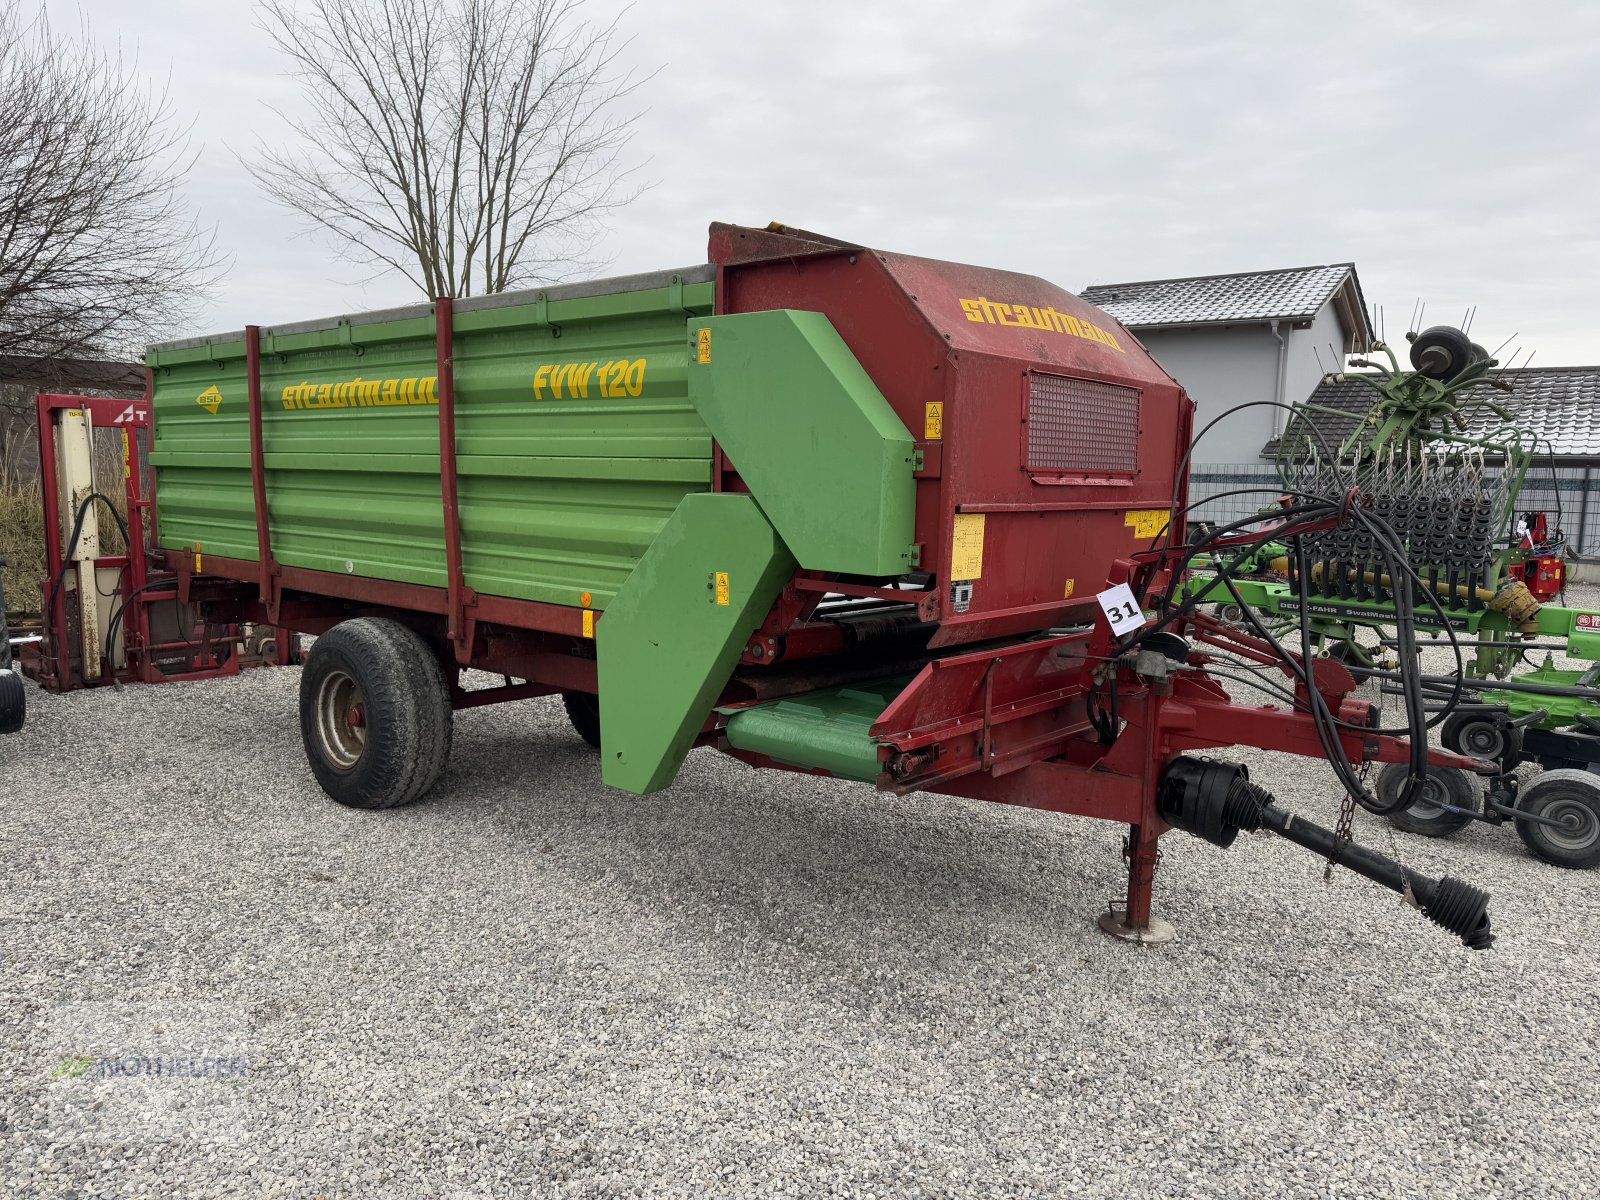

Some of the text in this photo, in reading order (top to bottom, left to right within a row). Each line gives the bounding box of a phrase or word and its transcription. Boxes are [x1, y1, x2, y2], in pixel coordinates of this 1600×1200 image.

[959, 297, 1126, 353] strautmann
[282, 377, 440, 410] strautmann
[533, 359, 647, 400] FVW 120
[199, 395, 219, 404] BSL
[1107, 601, 1138, 624] 31
[1280, 603, 1337, 614] DEU-FAHR
